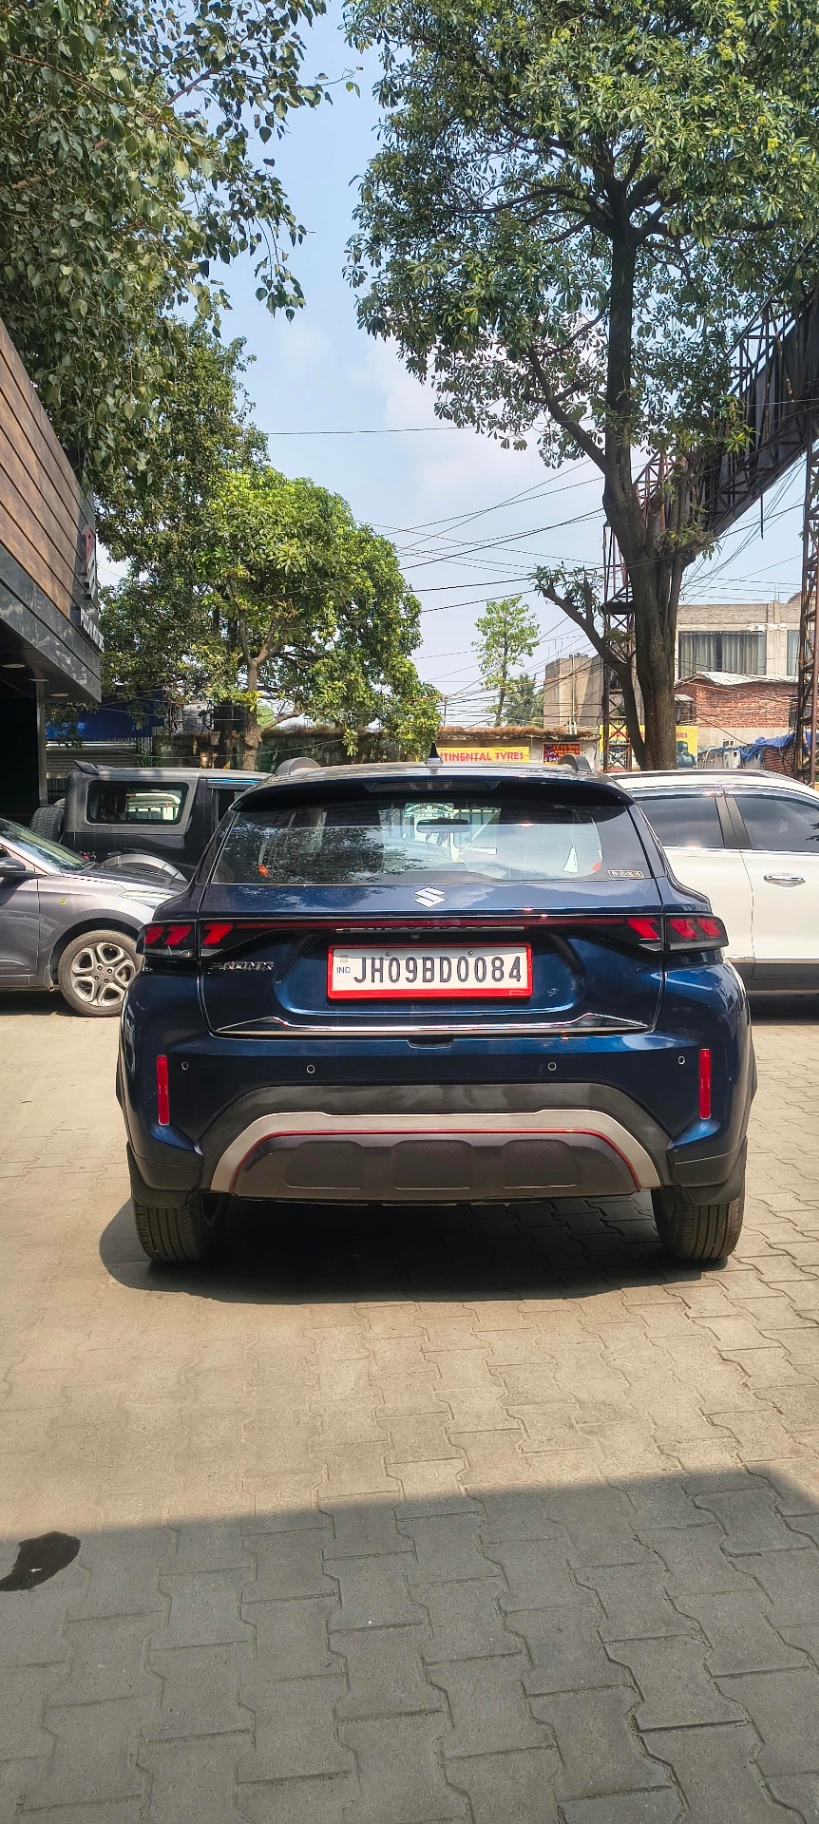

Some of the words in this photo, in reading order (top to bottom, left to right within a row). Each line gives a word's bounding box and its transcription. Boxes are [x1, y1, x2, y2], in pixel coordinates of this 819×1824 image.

[495, 751, 524, 760] TYRES
[336, 966, 351, 974] IND
[353, 955, 523, 983] JH09BD0084
